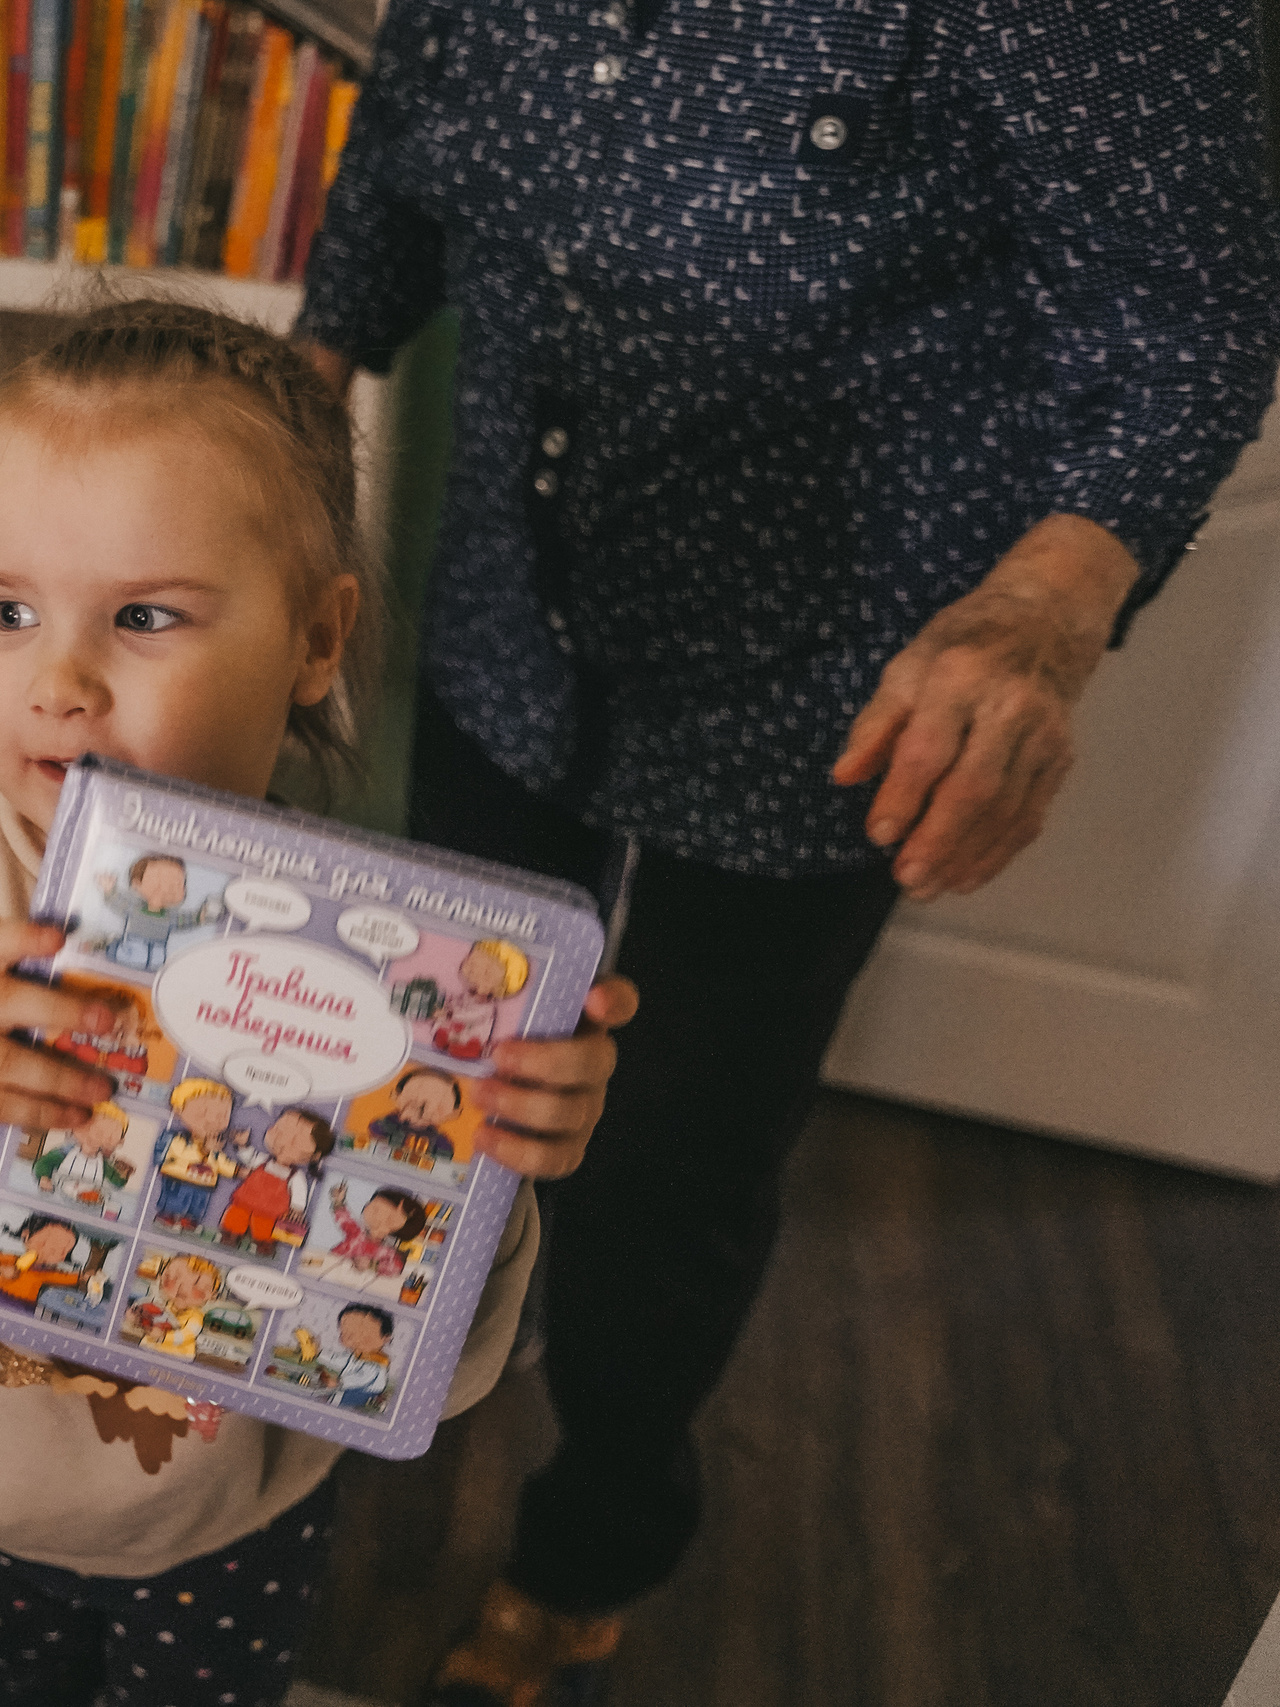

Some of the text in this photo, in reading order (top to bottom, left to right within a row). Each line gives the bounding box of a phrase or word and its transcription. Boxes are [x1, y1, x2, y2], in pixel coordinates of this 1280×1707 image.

[329, 865, 393, 900] для
[404, 886, 538, 943] малышей
[227, 950, 357, 1020] Правила
[196, 1000, 358, 1065] поведения
